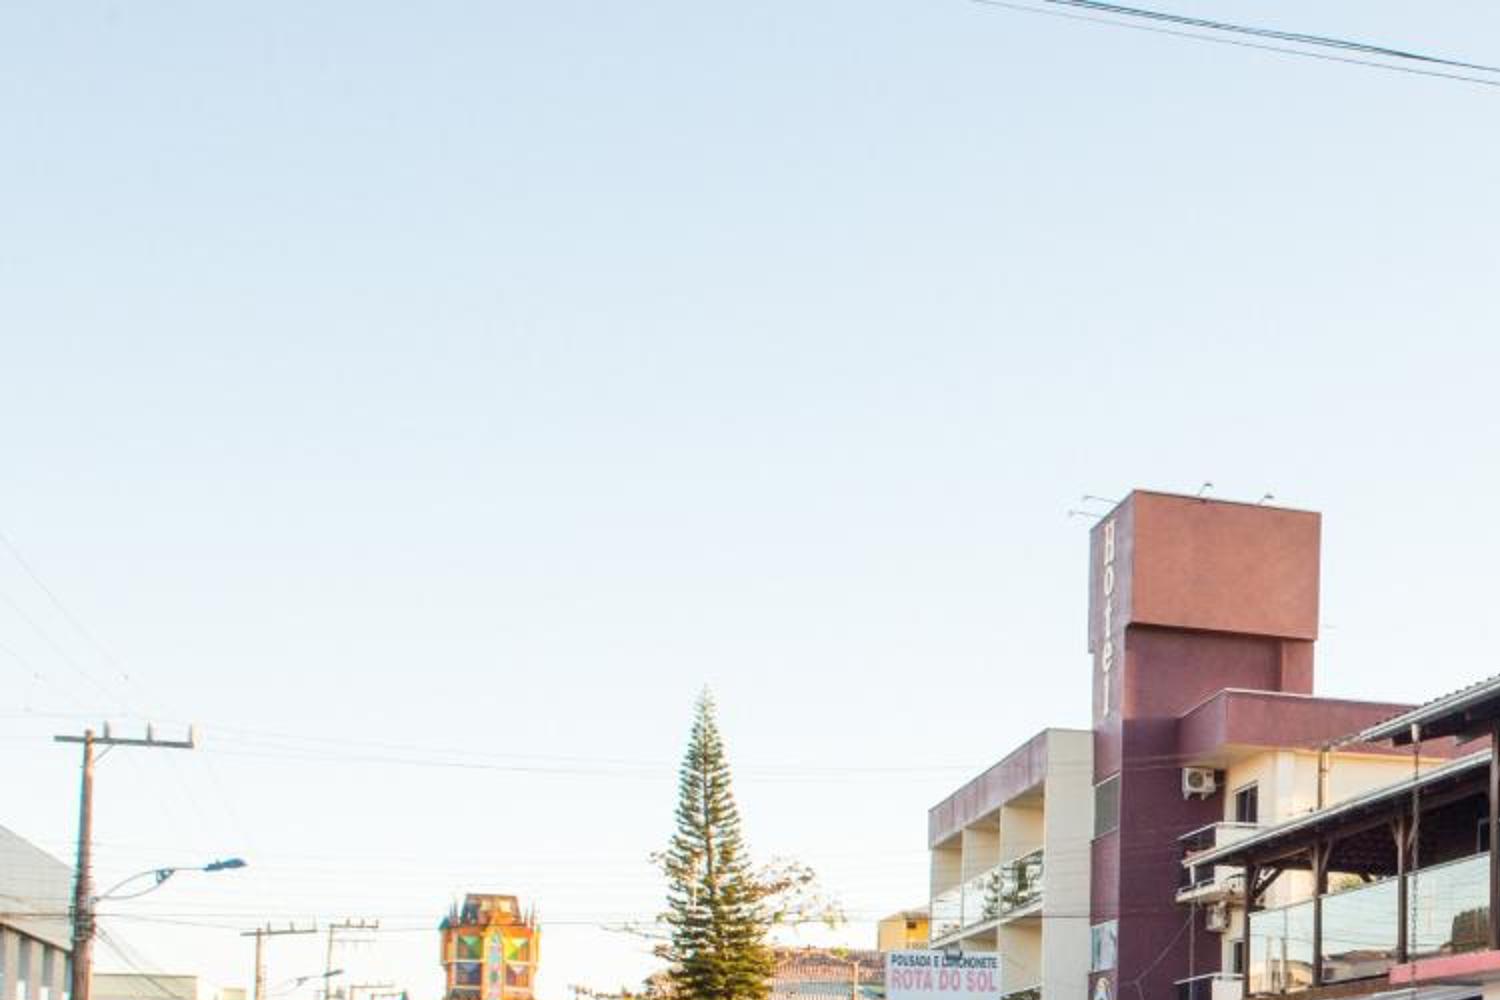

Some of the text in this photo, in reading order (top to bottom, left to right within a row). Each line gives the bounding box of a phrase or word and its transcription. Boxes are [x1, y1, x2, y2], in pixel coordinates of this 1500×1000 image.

[1104, 519, 1115, 717] Hotel
[891, 954, 931, 967] POUSADA
[934, 955, 939, 968] E
[891, 969, 997, 992] ROTA DO SOL
